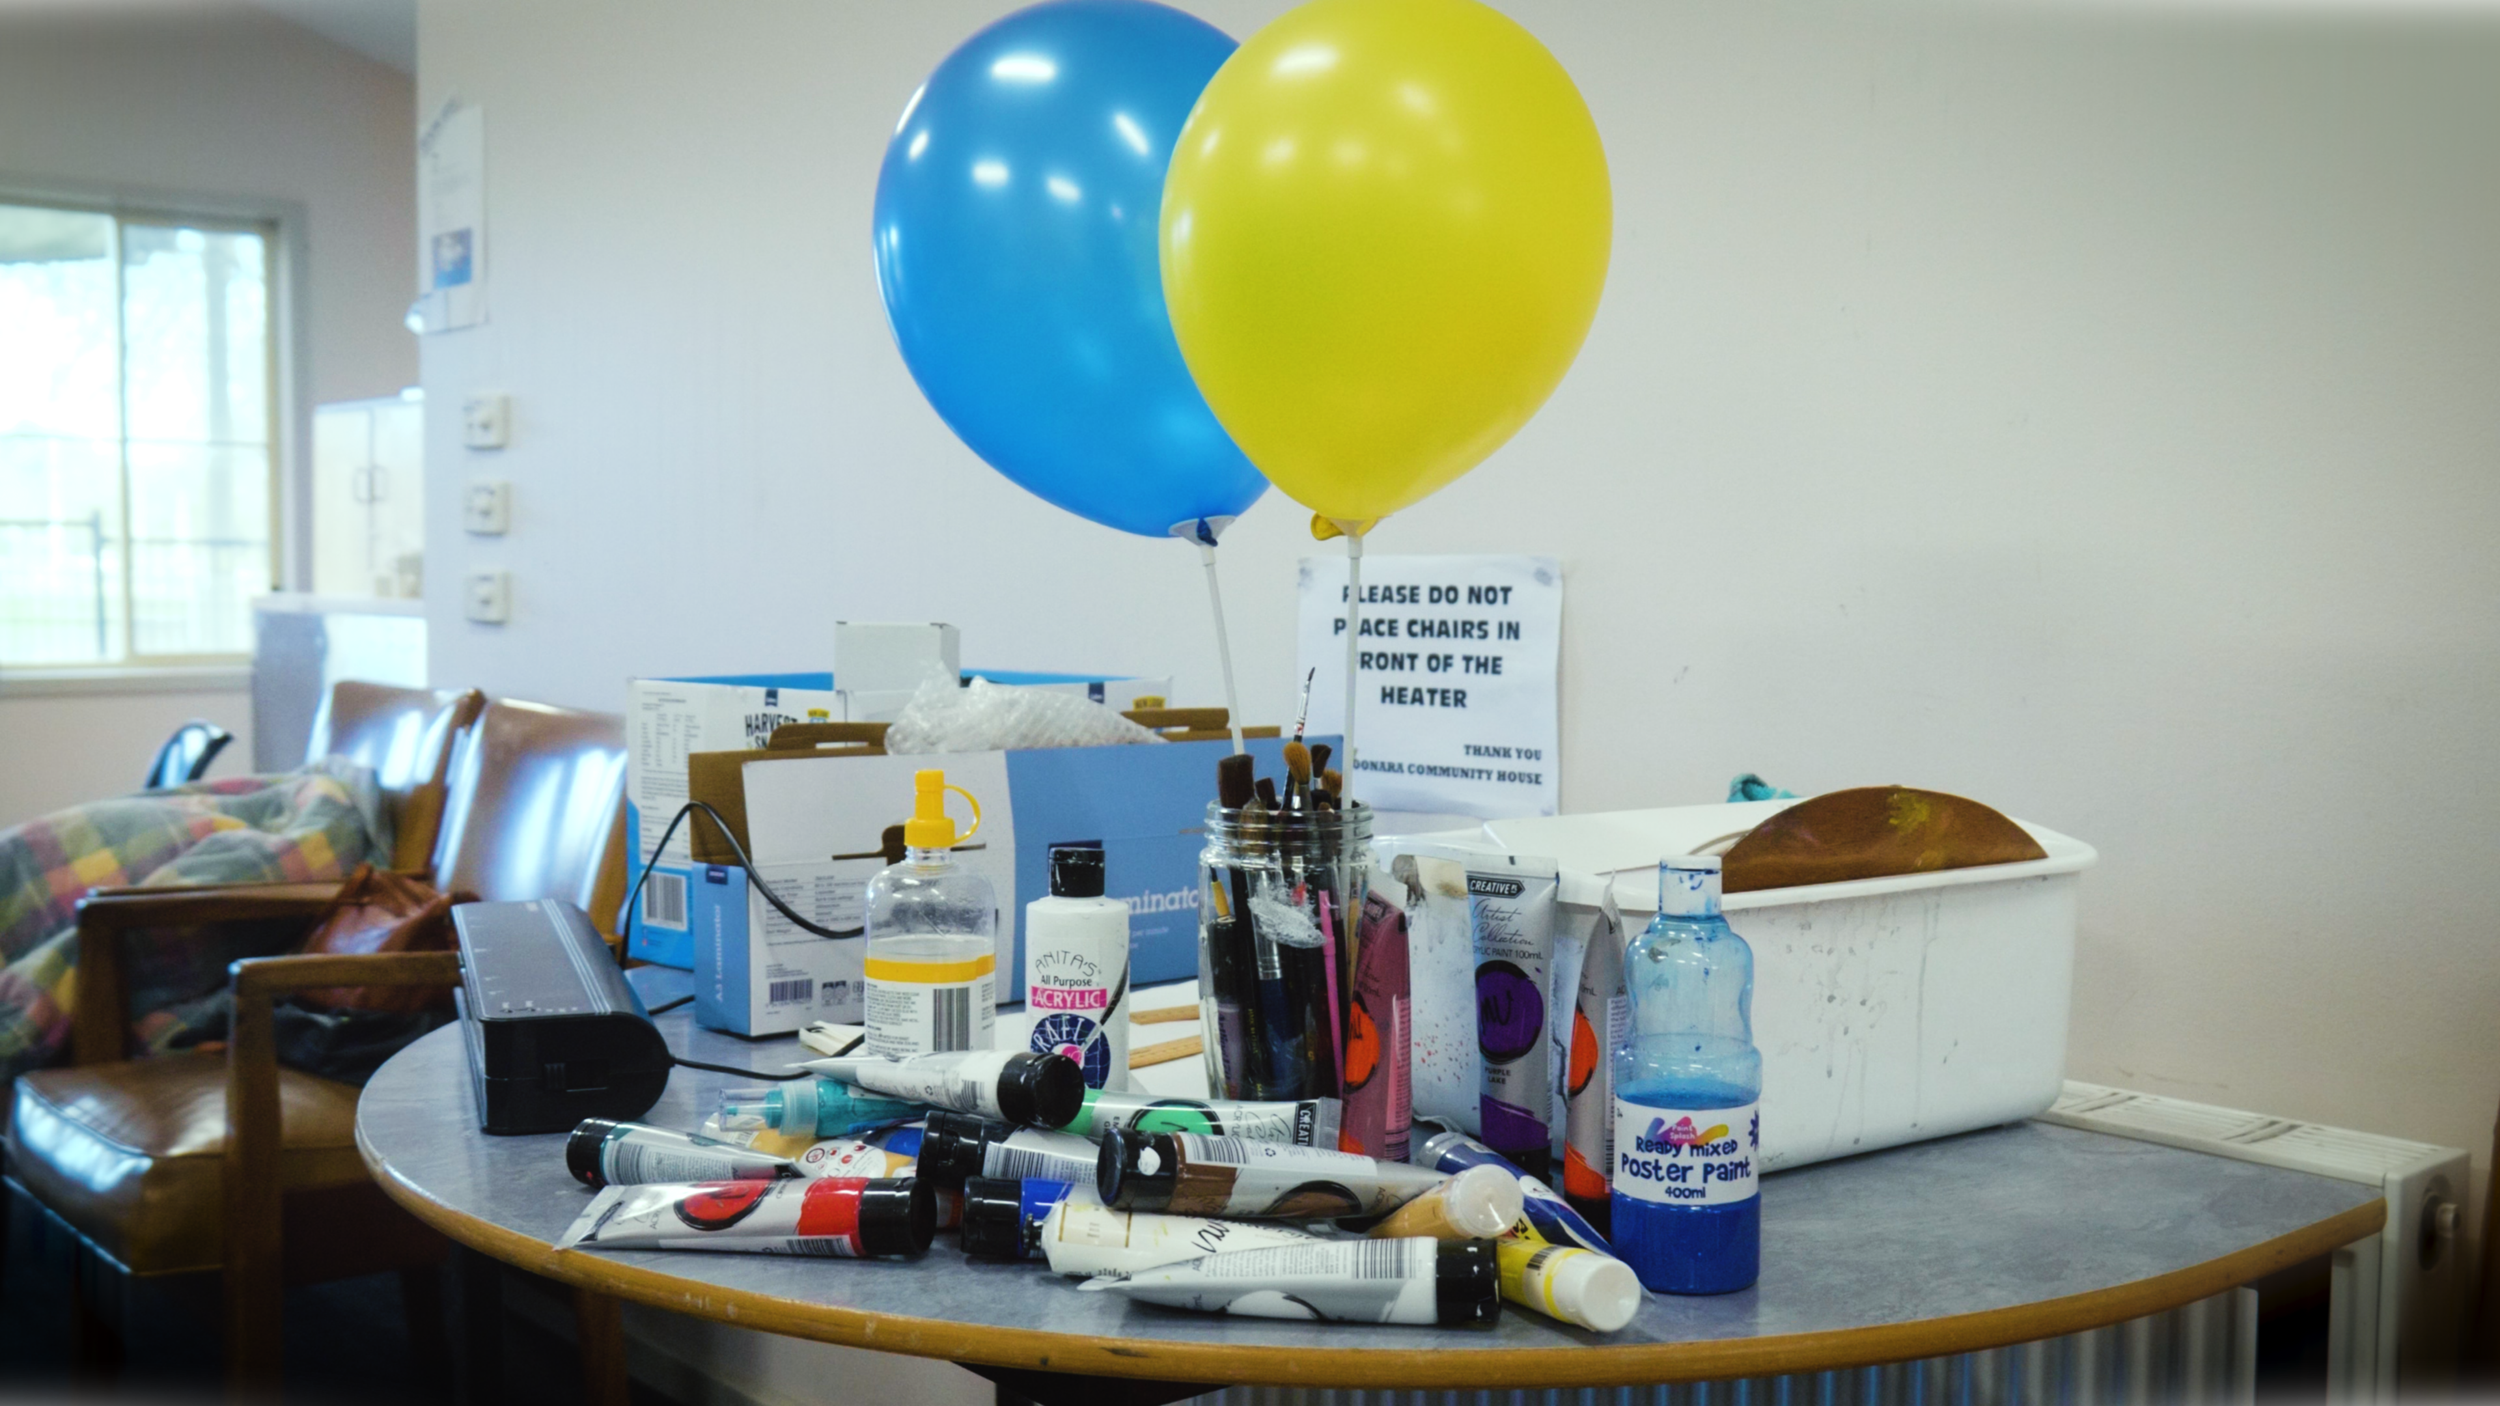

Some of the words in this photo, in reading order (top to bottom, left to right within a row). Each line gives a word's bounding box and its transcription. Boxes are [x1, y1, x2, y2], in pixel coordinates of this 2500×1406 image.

[1342, 585, 1420, 604] PLEASE
[1429, 585, 1459, 604] DO
[1468, 586, 1513, 605] NOT
[1334, 618, 1398, 637] PACE
[1407, 619, 1489, 640] CHAIRS
[1498, 622, 1520, 640] IN
[1356, 652, 1418, 671] RONT
[1427, 654, 1454, 672] OF
[1462, 655, 1502, 675] THE
[1380, 686, 1467, 708] HEATER
[1464, 744, 1512, 759] THANK
[1515, 747, 1542, 761] YOU
[1408, 763, 1493, 781] COMMUNITY
[1496, 770, 1542, 785] HOUSE
[1470, 880, 1510, 894] CREATIVE
[1472, 898, 1522, 922] Artist
[1473, 922, 1534, 946] Collection
[1035, 950, 1098, 977] ANITA'S
[1491, 947, 1513, 958] PAINT
[1515, 950, 1543, 960] 100mL
[1040, 975, 1051, 985] All
[1053, 976, 1093, 989] Purpose
[1034, 990, 1101, 1008] ACRYLIC
[1033, 1015, 1086, 1052] RAFT
[1484, 1066, 1511, 1077] PURPLE
[1487, 1075, 1506, 1085] LAKE
[1300, 1109, 1312, 1146] CREATI
[1669, 1132, 1696, 1141] Splash
[1672, 1124, 1693, 1132] Paint
[1621, 1153, 1694, 1183] Poster
[1665, 1186, 1706, 1199] 400ml
